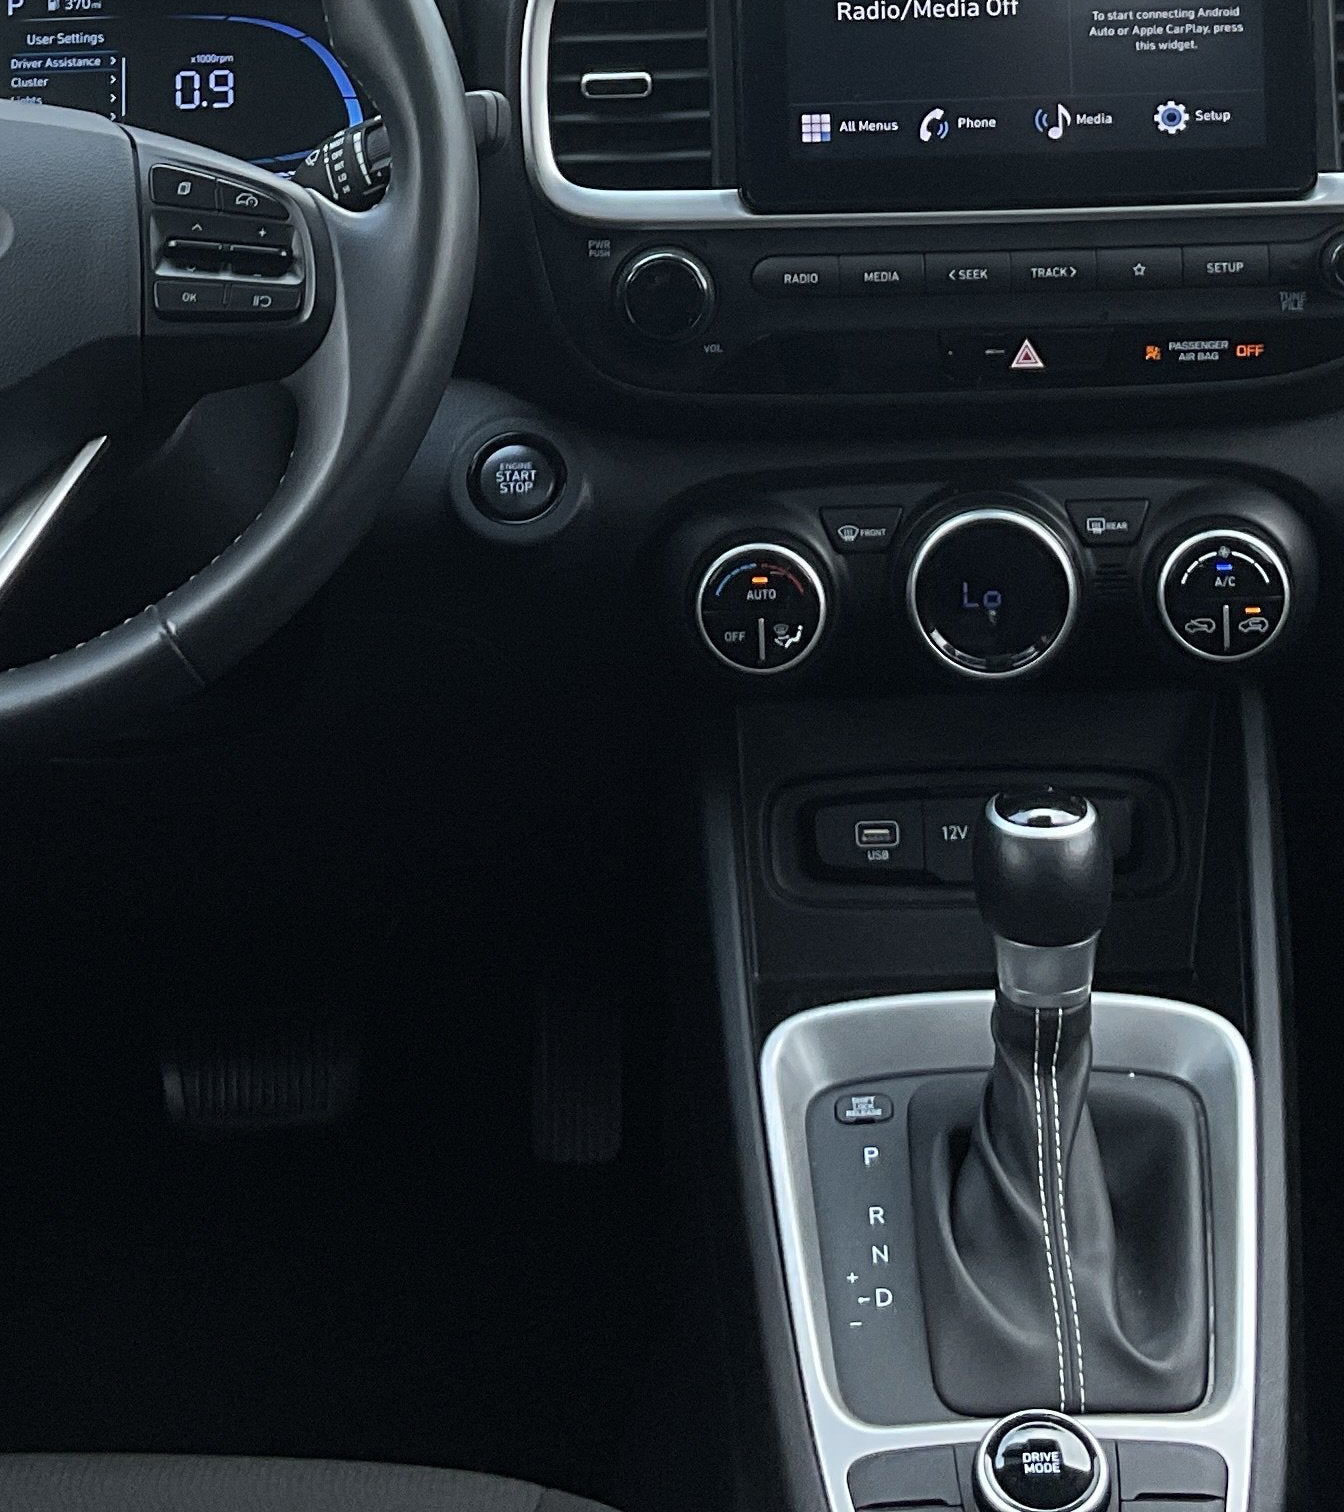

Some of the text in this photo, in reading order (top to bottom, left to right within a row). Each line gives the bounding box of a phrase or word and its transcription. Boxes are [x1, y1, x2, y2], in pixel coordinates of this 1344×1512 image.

[1092, 6, 1240, 21] To start connecting Android
[1089, 26, 1115, 37] Auto
[1117, 26, 1130, 36] or
[1132, 24, 1164, 37] Apple
[1213, 23, 1244, 35] press
[26, 31, 105, 47] User Settings
[1135, 39, 1198, 52] this widget.
[10, 55, 102, 70] Driver Assistance
[10, 77, 49, 88] Cluster
[175, 70, 234, 110] 0.9
[1075, 110, 1114, 127] Media
[1194, 106, 1232, 124] Setup
[839, 117, 899, 134] All Menus
[957, 114, 997, 131] Phone
[587, 240, 611, 249] PWR
[1030, 267, 1067, 279] TRACK
[1206, 261, 1244, 274] SETUP
[783, 273, 818, 284] RADIO
[863, 272, 899, 283] MEDIA
[958, 269, 987, 281] SEEK
[182, 292, 197, 303] OK
[1279, 291, 1307, 301] TUNE
[703, 343, 724, 353] VOL
[1168, 341, 1228, 351] PASSENGER
[1235, 345, 1264, 358] OFF
[1178, 351, 1219, 362] AIR BAG
[499, 461, 533, 470] ENGINE
[496, 470, 536, 482] START
[499, 481, 533, 494] STOP
[1105, 520, 1128, 531] REAR
[859, 528, 886, 537] FRONT
[1214, 576, 1236, 587] A/C
[746, 588, 777, 600] AUTO
[724, 631, 755, 643] OFF
[942, 825, 968, 841] 12V
[867, 849, 890, 861] USB
[863, 1146, 879, 1166] P
[868, 1206, 885, 1225] R
[871, 1244, 889, 1264] N
[875, 1287, 893, 1307] D
[1022, 1451, 1060, 1463] DRIVE
[1024, 1462, 1061, 1474] MODE
